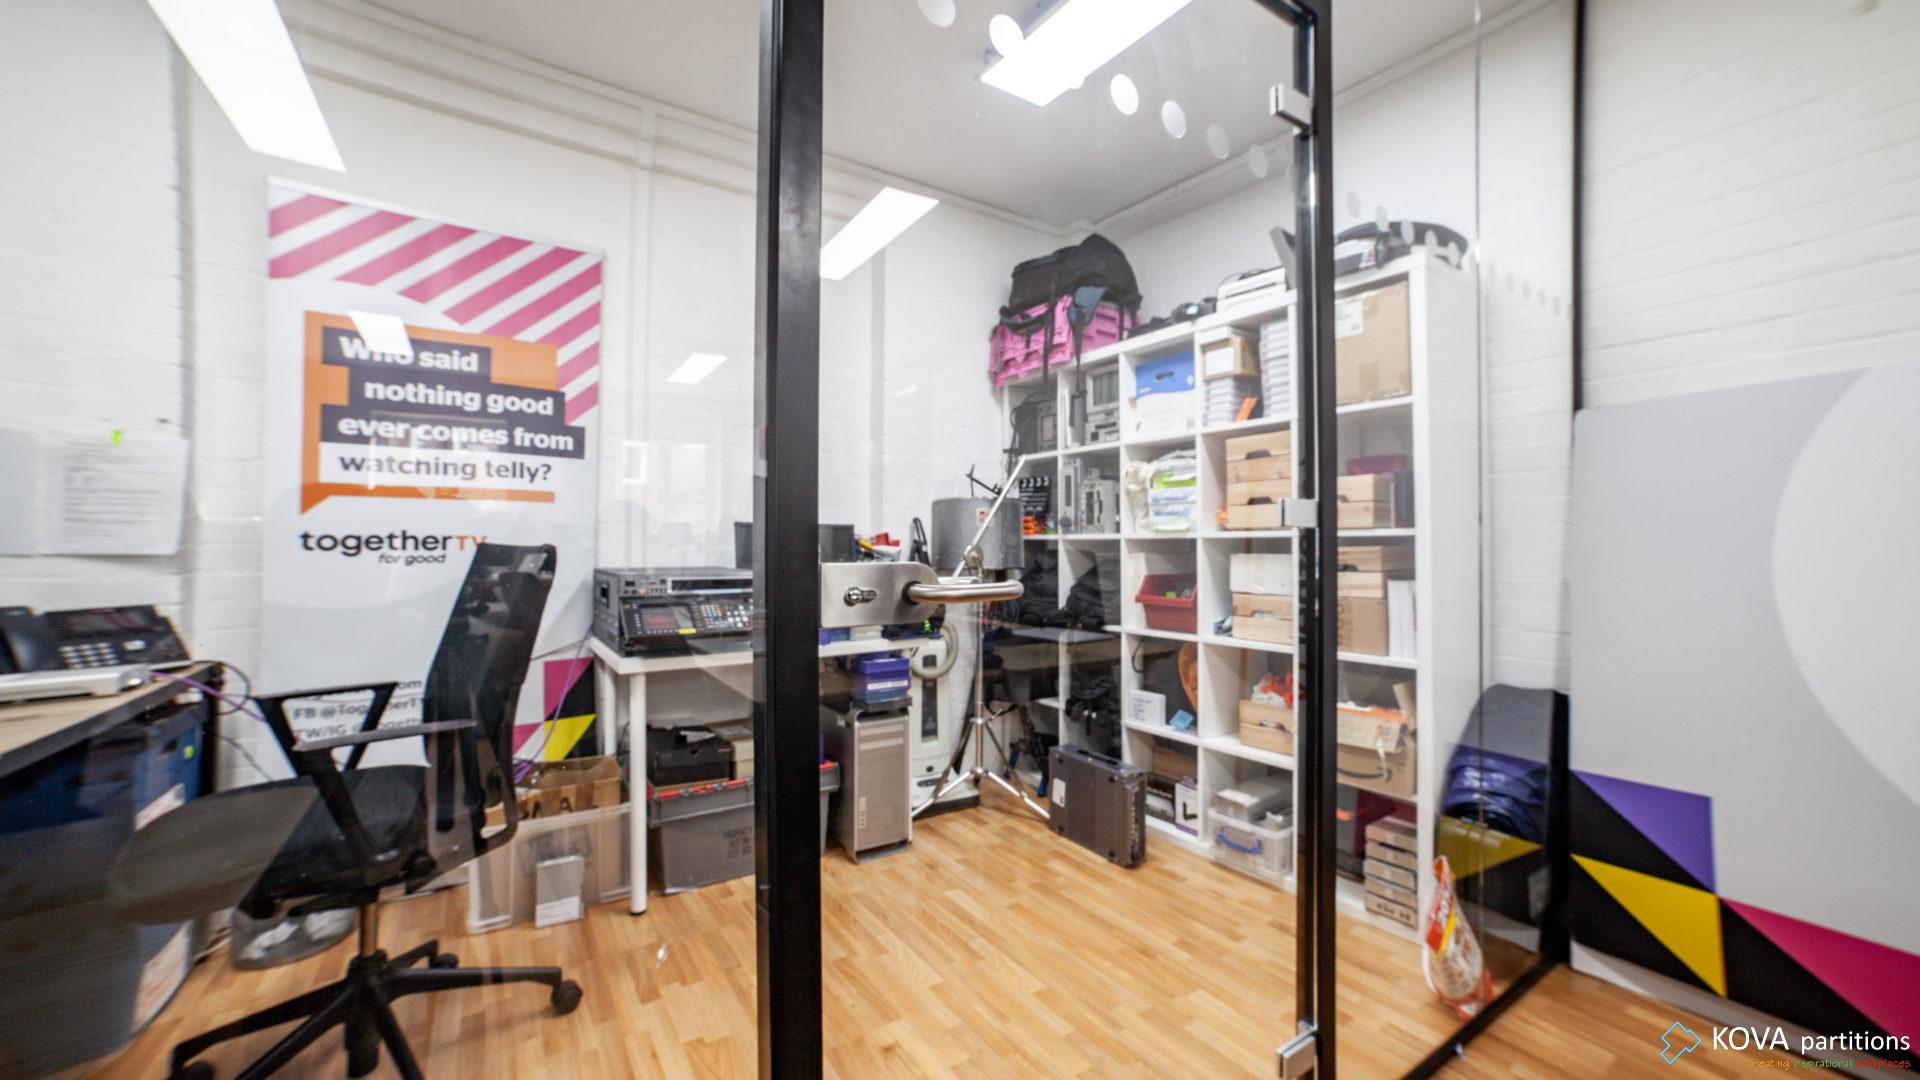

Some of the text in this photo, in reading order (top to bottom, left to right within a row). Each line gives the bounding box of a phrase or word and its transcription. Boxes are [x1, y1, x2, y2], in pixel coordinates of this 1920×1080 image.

[419, 350, 479, 372] said
[364, 380, 553, 416] nothing good
[337, 417, 574, 451] ever comes from
[339, 455, 552, 483] watching telly?
[378, 552, 446, 566] for good
